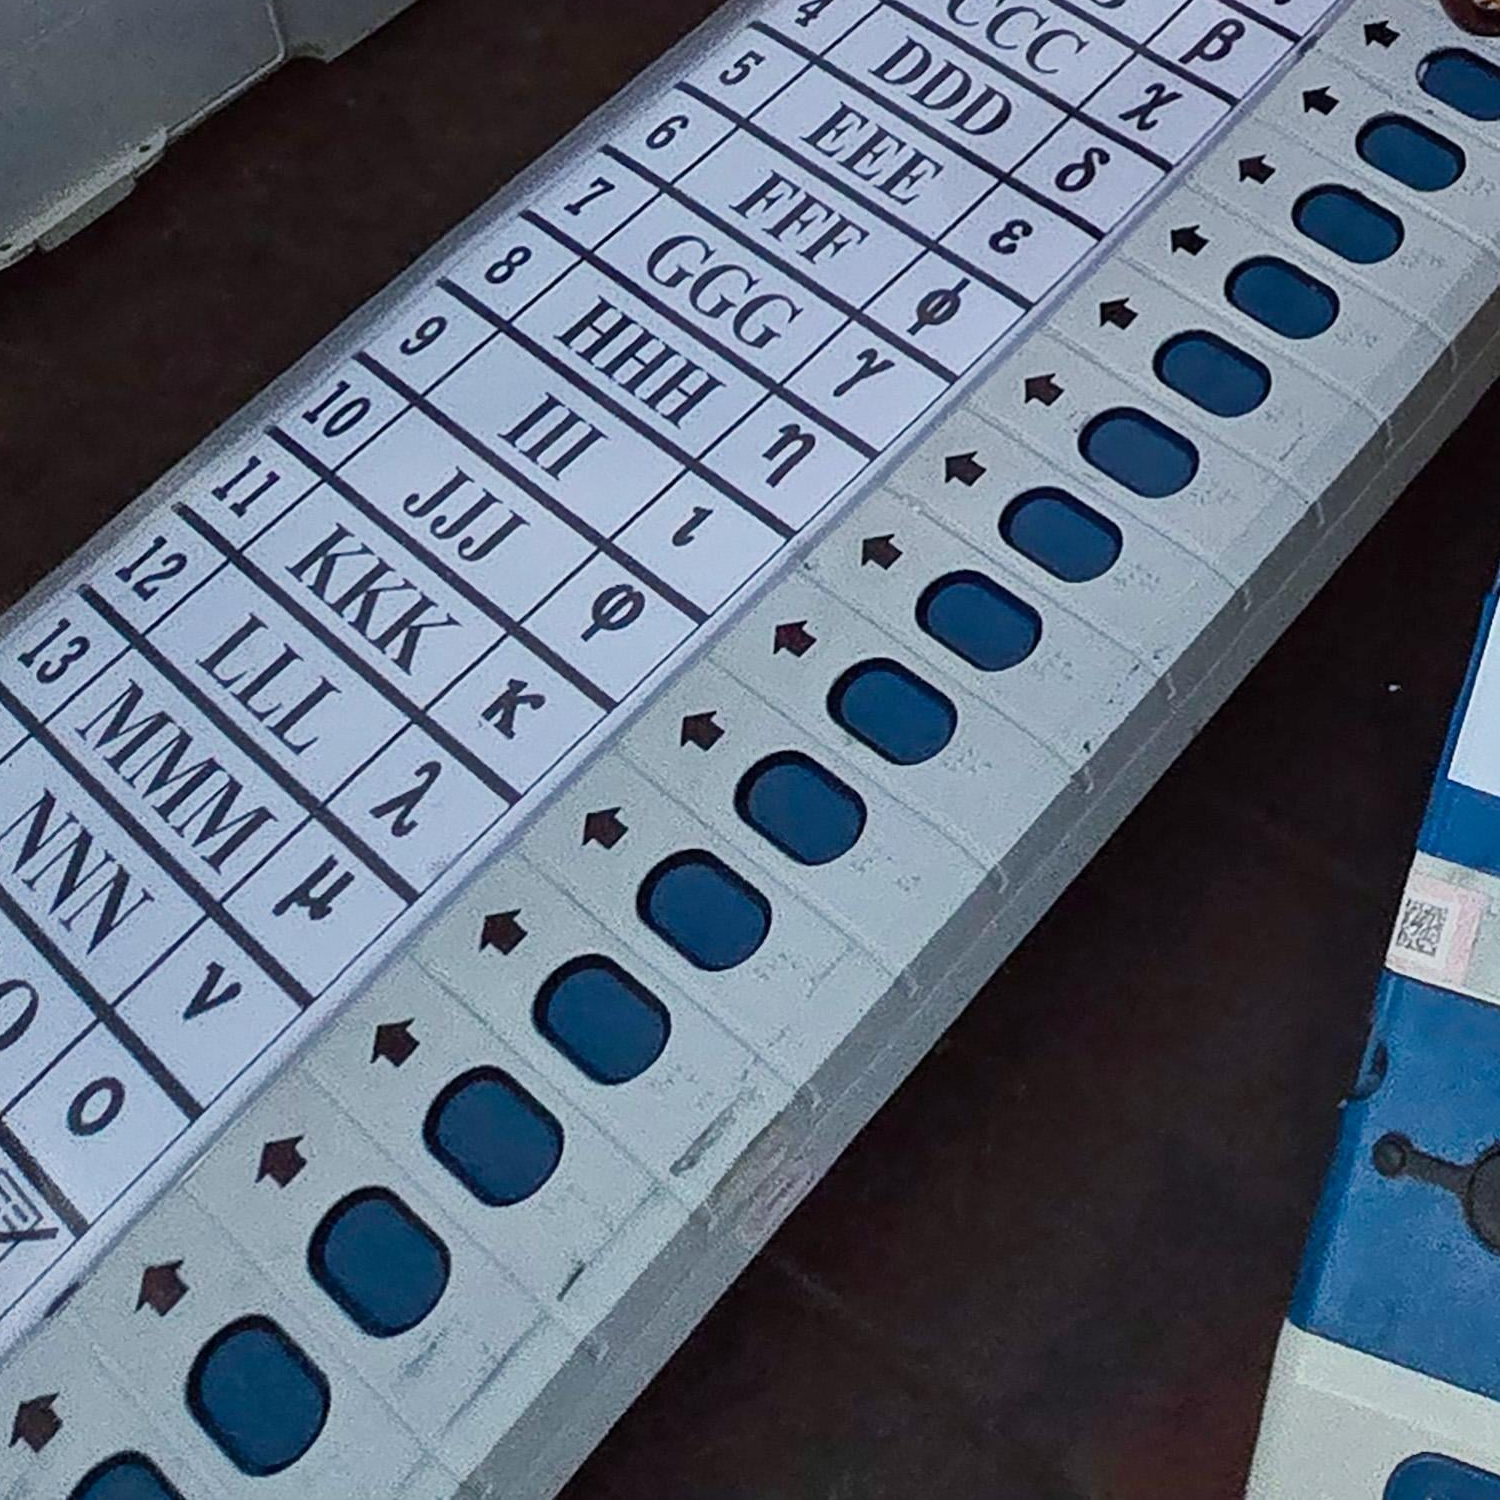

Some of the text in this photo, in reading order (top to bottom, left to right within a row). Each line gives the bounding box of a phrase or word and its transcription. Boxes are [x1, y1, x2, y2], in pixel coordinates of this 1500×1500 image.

[868, 36, 1012, 135] DDD
[1055, 148, 1110, 192] δ
[1178, 19, 1245, 64] β
[646, 116, 689, 149] 6
[729, 170, 869, 264] FFF
[719, 51, 765, 85] 5
[800, 101, 944, 205] EEE
[485, 246, 531, 284] 8
[554, 296, 725, 429] HHH
[564, 177, 615, 216] 7
[647, 236, 803, 348] GGG
[302, 381, 370, 437] 10
[403, 466, 530, 561] JJJ
[400, 317, 447, 355] 9
[498, 392, 608, 480] III
[211, 456, 280, 518] 11
[285, 523, 460, 675] KKK
[18, 618, 90, 683] 13
[75, 679, 278, 874] MMM
[115, 536, 441, 837] 12 LLL λ
